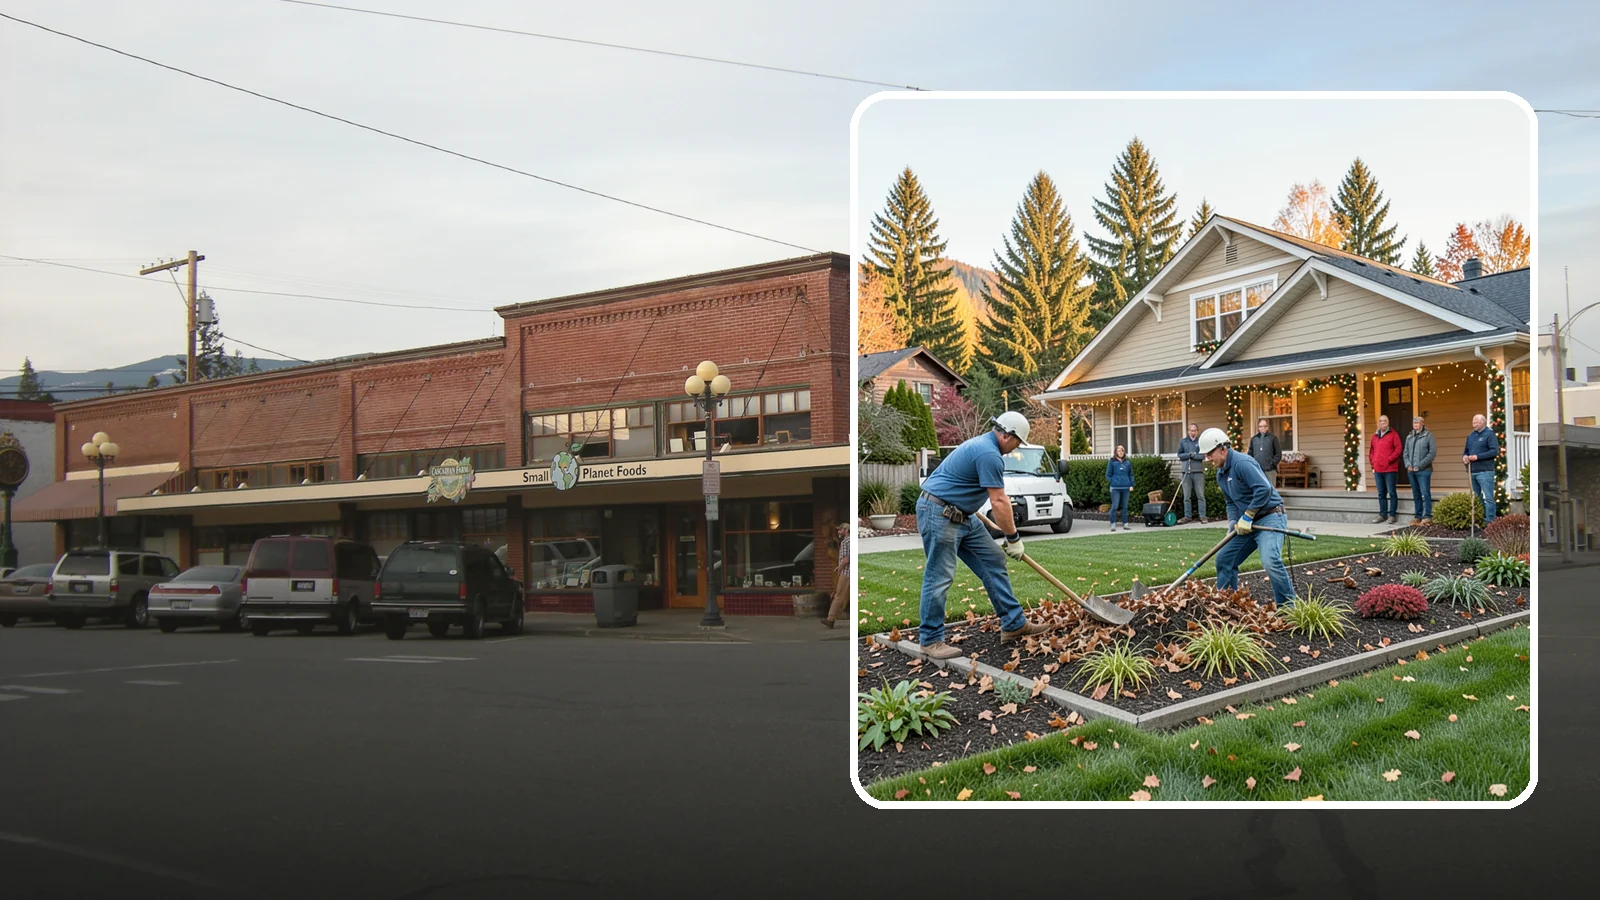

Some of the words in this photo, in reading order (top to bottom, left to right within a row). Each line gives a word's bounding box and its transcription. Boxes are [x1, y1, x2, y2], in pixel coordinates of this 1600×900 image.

[523, 471, 549, 483] Small
[582, 467, 614, 479] Planet
[617, 464, 647, 476] Foods
